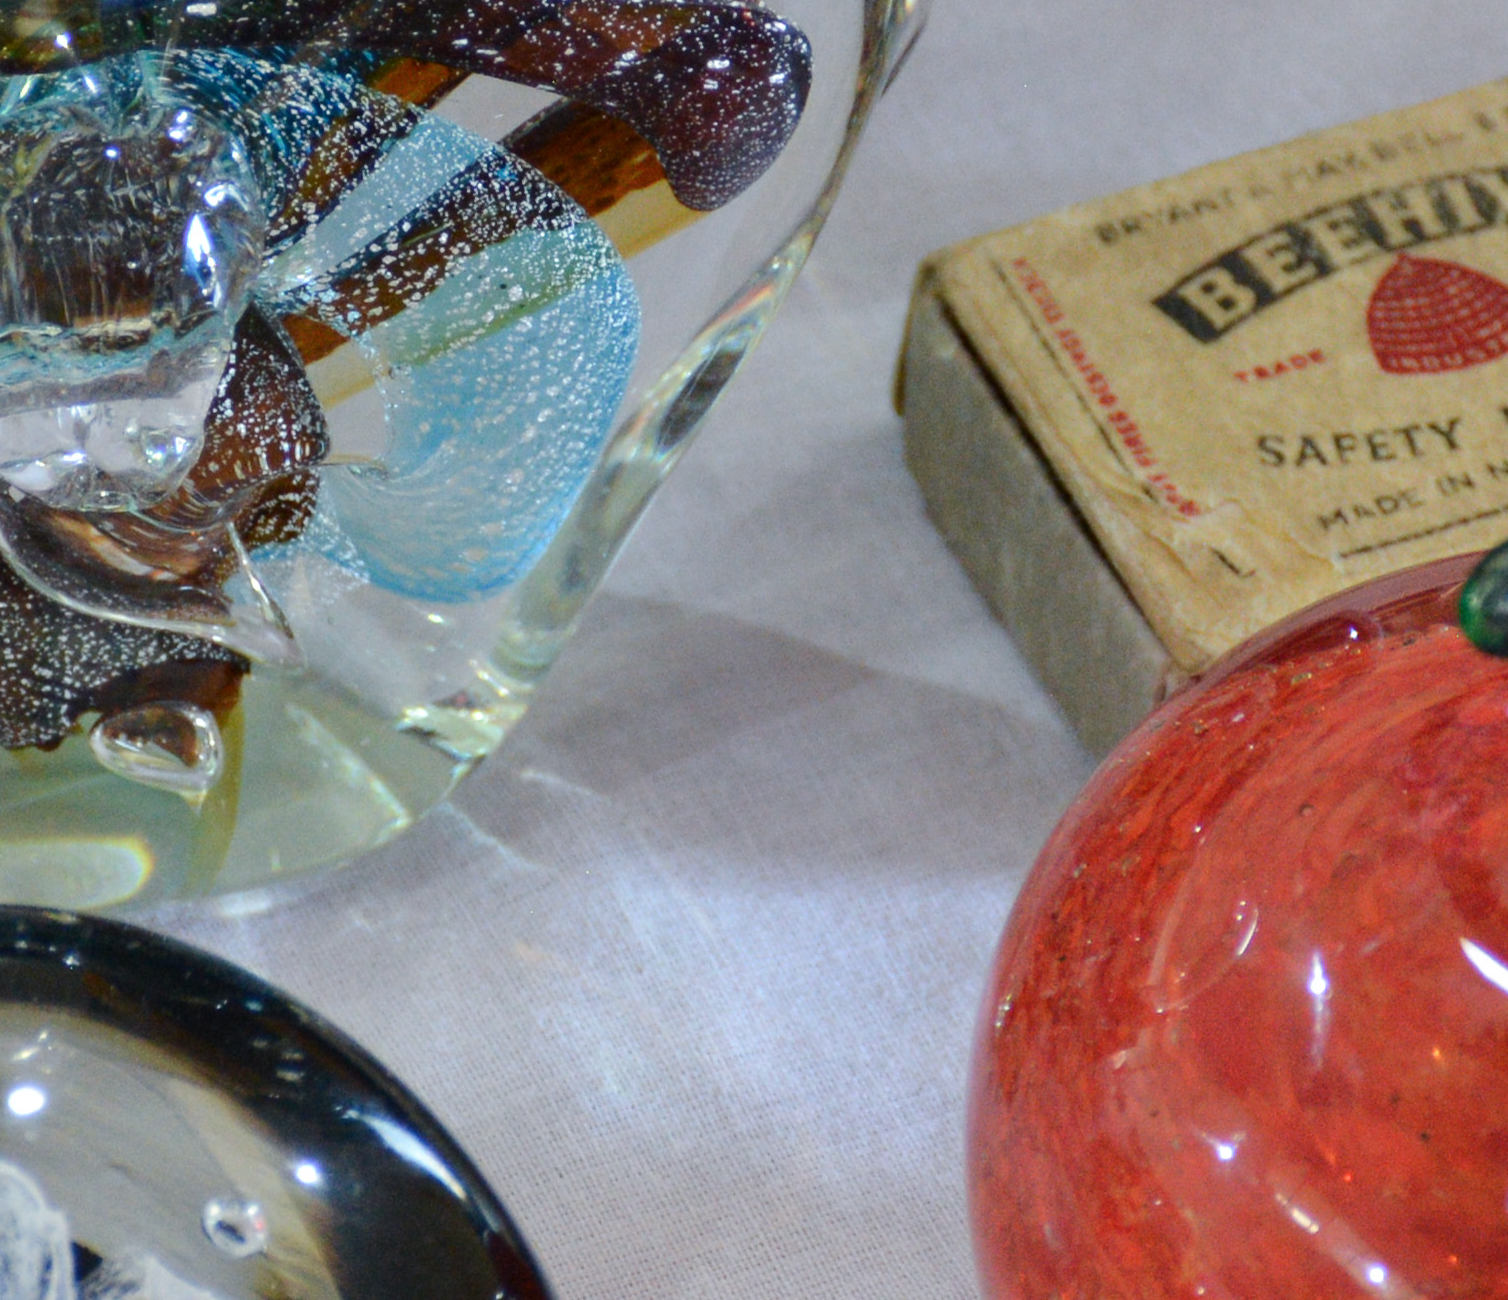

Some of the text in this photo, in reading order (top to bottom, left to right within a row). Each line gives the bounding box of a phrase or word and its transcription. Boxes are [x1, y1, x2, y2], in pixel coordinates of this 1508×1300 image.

[1233, 347, 1327, 384] TRADE
[1255, 415, 1464, 468] SAFETY
[1317, 486, 1425, 532] MADE
[1435, 472, 1476, 498] IN
